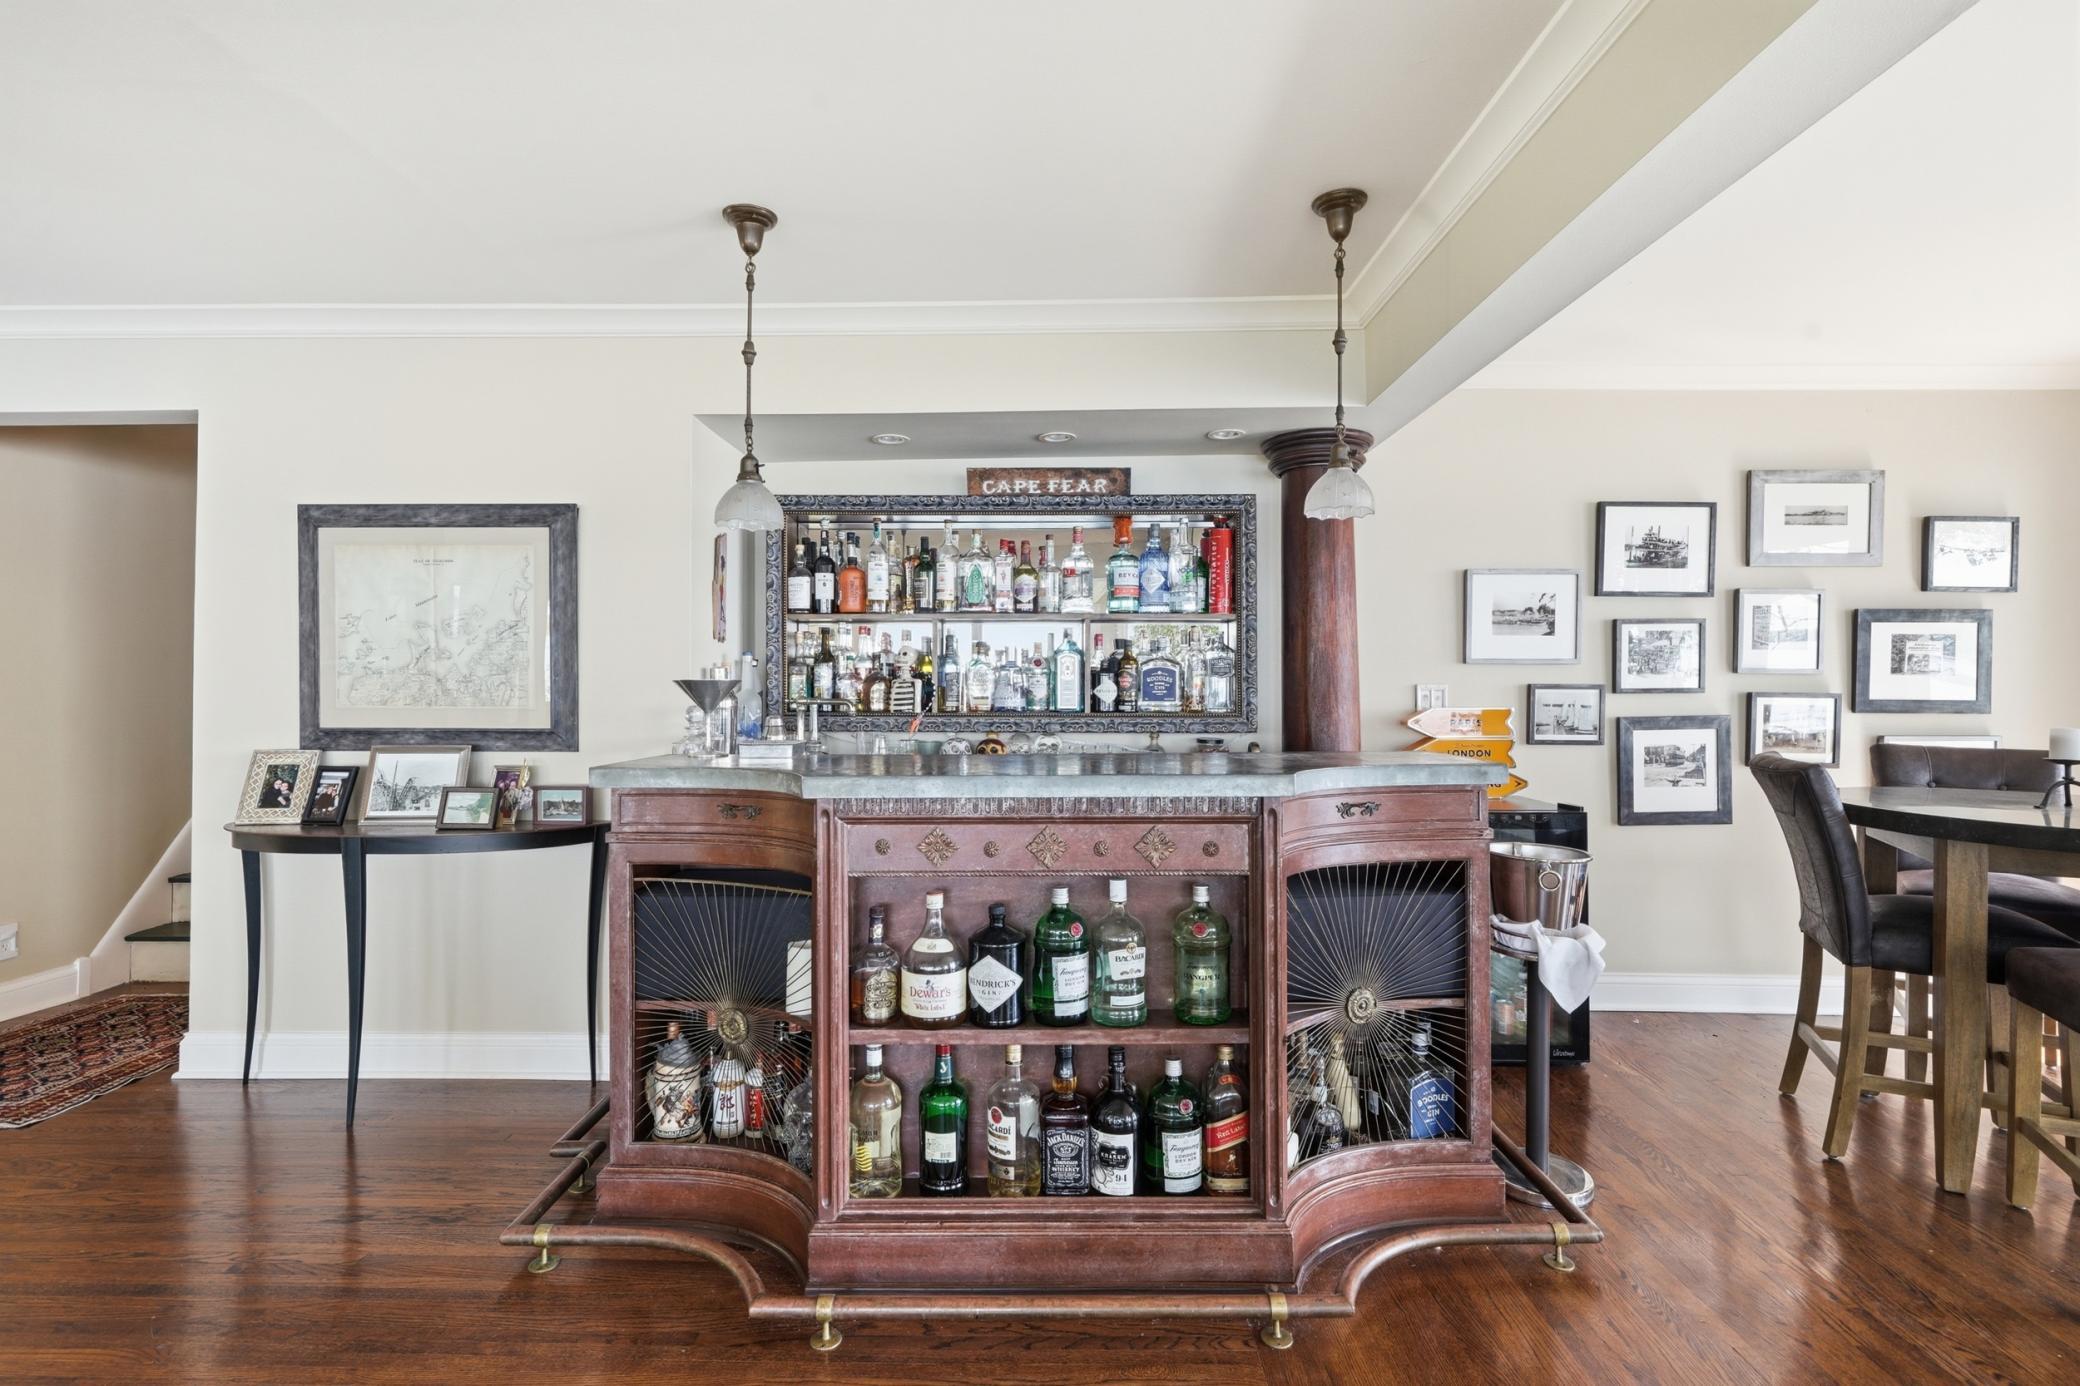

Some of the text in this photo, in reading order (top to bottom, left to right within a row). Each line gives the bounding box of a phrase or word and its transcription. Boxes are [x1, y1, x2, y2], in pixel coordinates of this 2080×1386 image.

[982, 479, 1107, 494] CAPE FEAR
[910, 985, 951, 998] Dewar's
